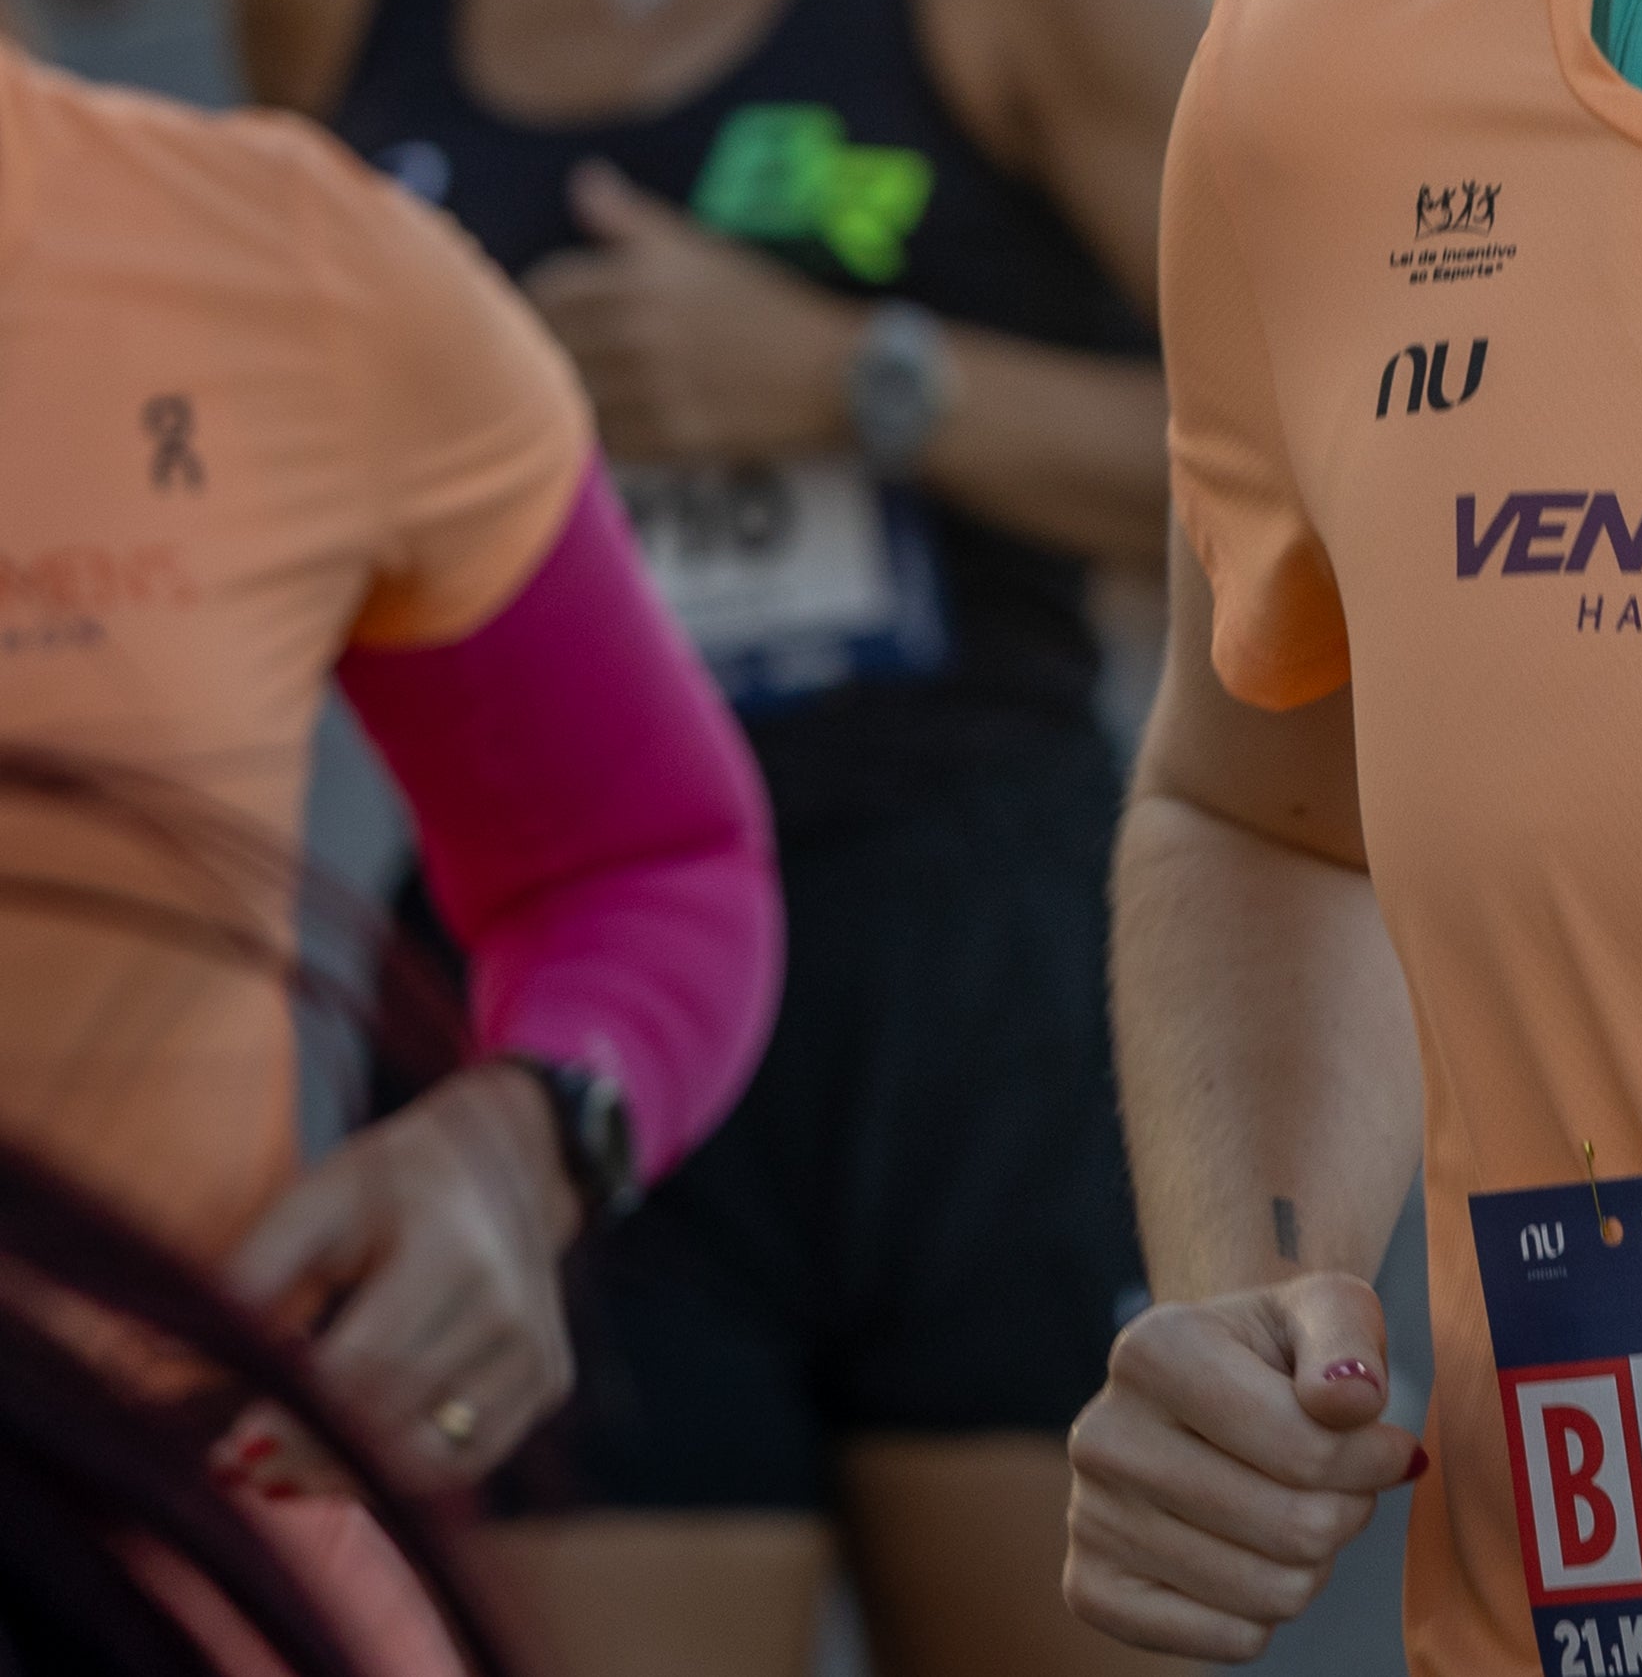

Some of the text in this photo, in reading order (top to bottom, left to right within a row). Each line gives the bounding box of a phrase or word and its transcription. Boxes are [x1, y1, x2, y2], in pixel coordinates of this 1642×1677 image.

[1390, 243, 1517, 268] Lei de Incentivo
[1541, 1403, 1618, 1571] B
